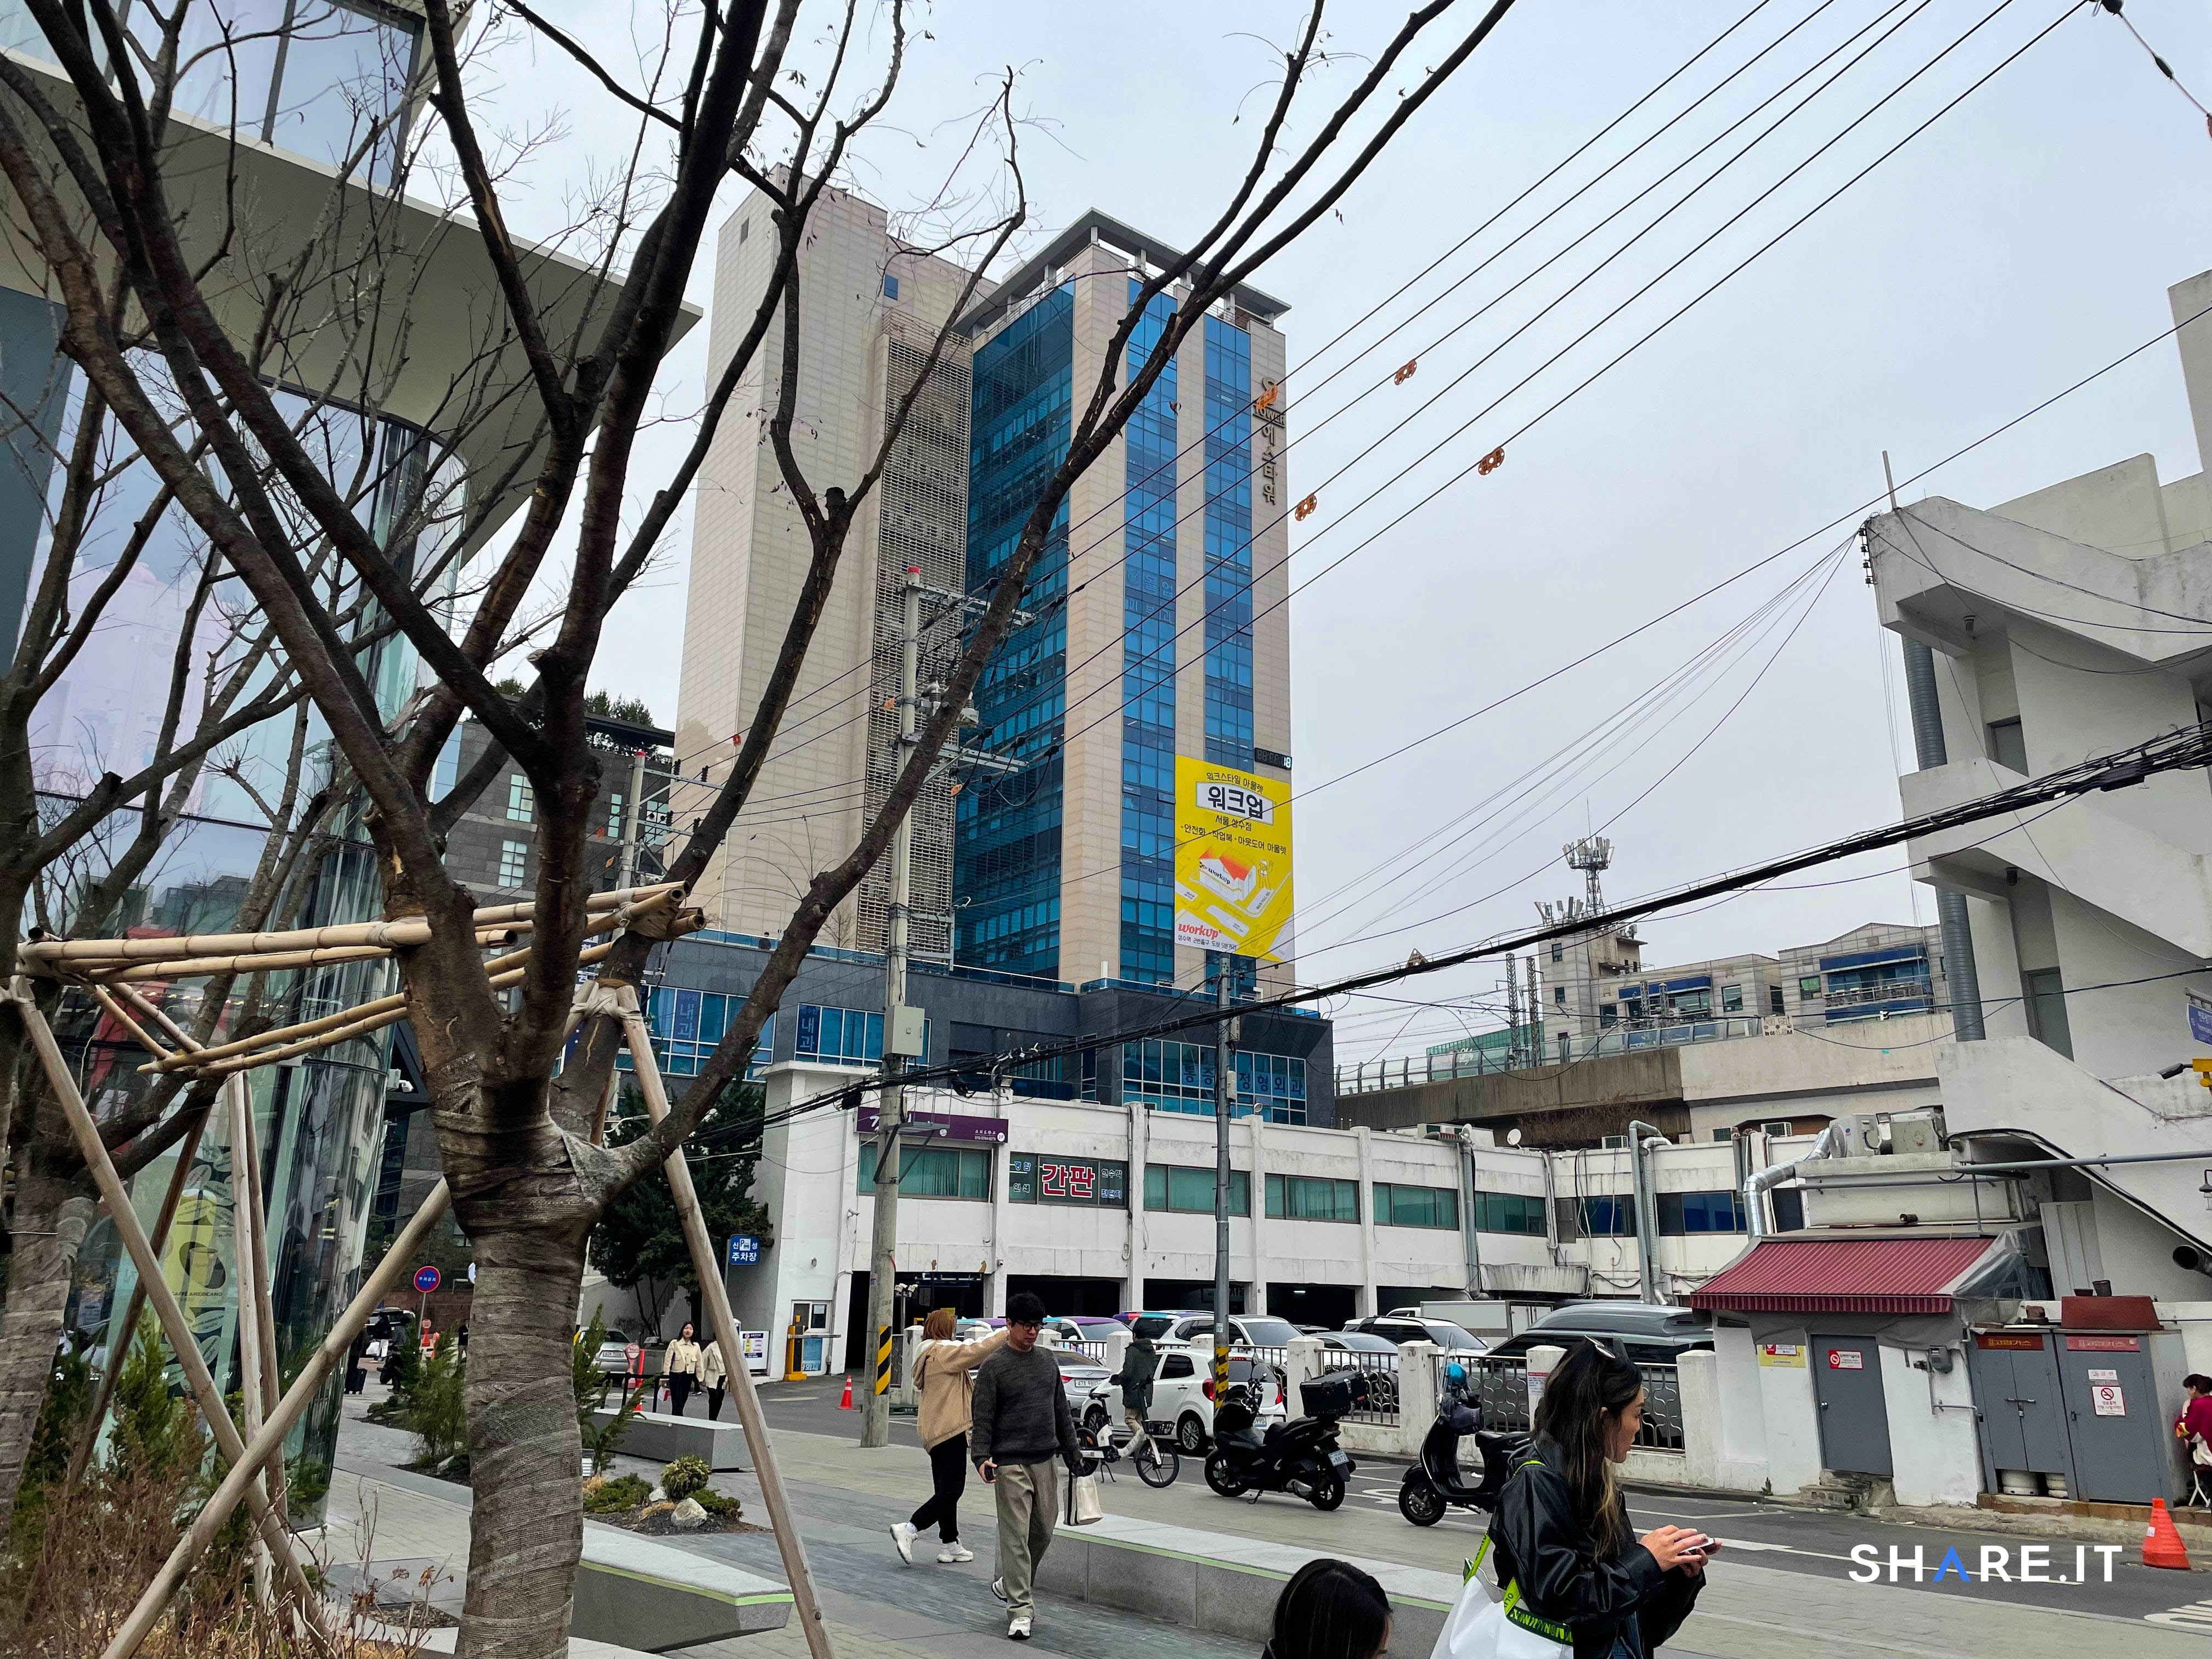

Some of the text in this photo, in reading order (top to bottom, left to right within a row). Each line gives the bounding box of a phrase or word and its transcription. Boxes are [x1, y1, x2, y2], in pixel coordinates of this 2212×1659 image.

[1261, 424, 1277, 505] 에스타워
[1207, 772, 1263, 794] 워크스타일 아울렛
[1208, 786, 1263, 819] 워크업
[1216, 815, 1252, 831] 서울 성수점
[1184, 823, 1286, 855] 안전화 작업복 아웃도어 아울렛
[1209, 868, 1231, 884] workup
[1178, 923, 1218, 940] workup
[677, 1002, 695, 1039] 내과
[799, 1017, 815, 1051] 내과
[1239, 1073, 1303, 1095] 정형외과
[1042, 1164, 1096, 1198] 간판
[1101, 1169, 1122, 1178] 현수막
[1101, 1188, 1122, 1199] 전단지
[731, 1252, 757, 1261] 주차장
